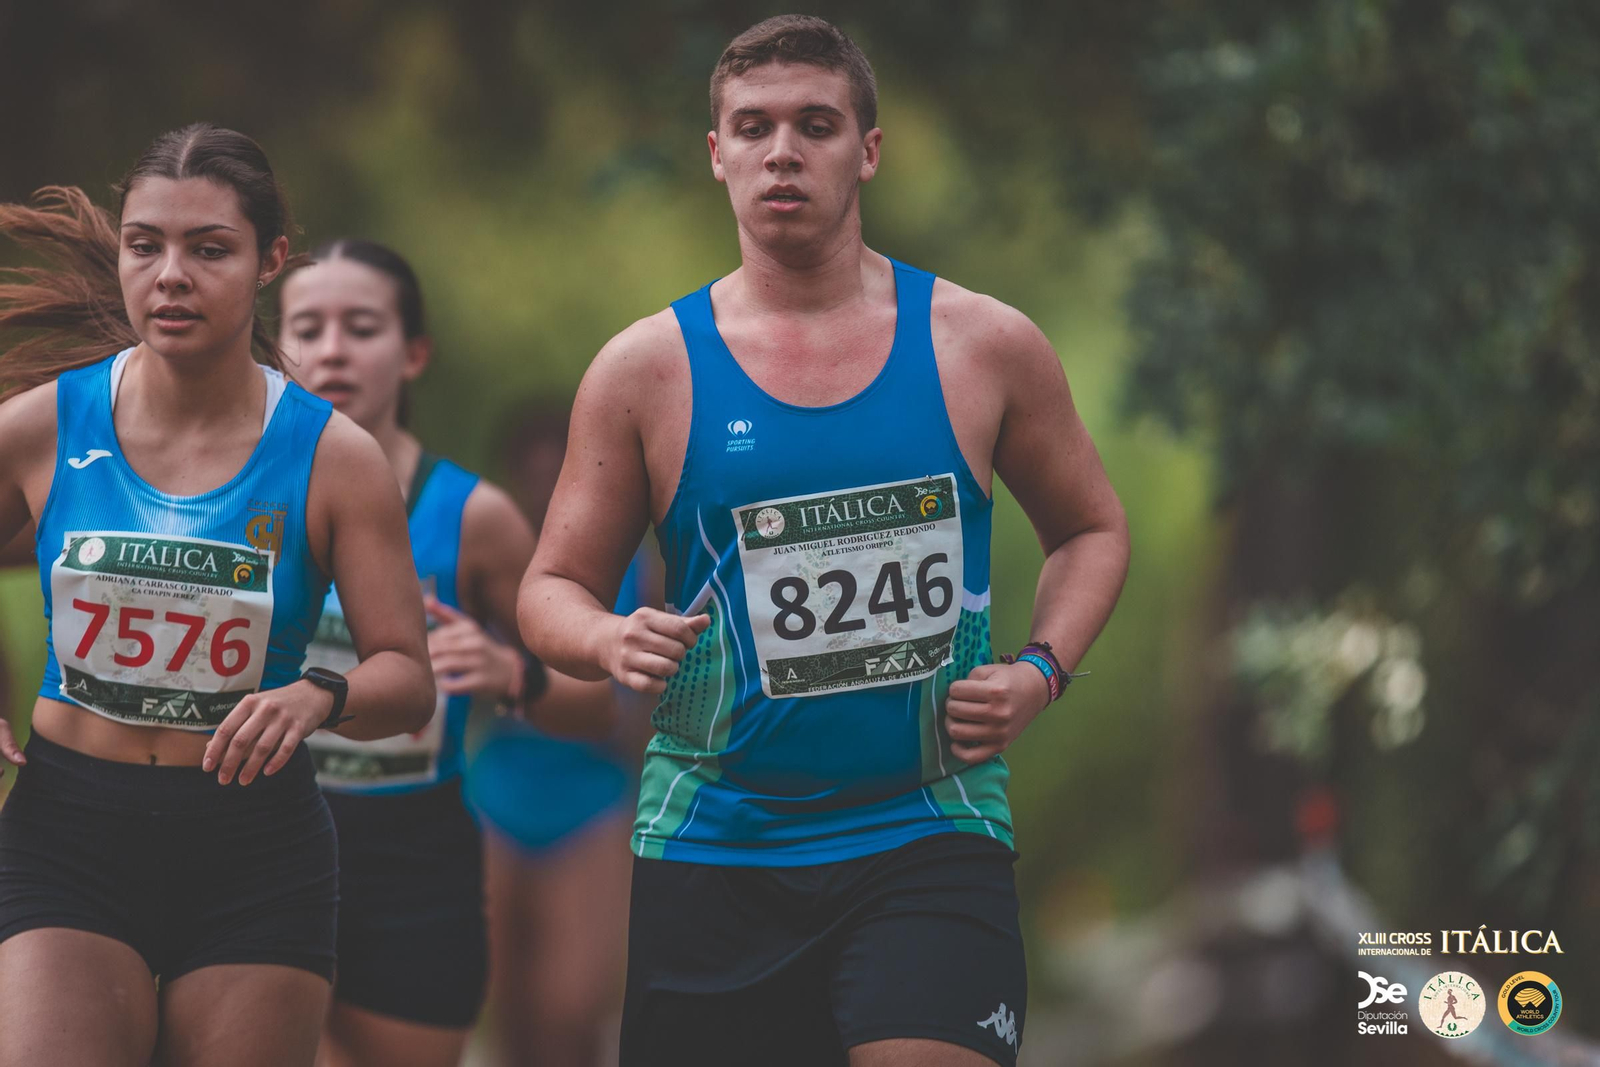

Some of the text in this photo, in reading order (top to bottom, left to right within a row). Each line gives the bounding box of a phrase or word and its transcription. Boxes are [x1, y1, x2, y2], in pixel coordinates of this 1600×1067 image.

[798, 493, 905, 528] ITÁLICA
[802, 521, 853, 534] INTERNATIONAL
[876, 513, 906, 522] COUNTRY
[773, 523, 936, 555] JUAN MIGUEL RODRIGUEZ REDONDO
[821, 540, 894, 557] ATLETISMO ORIPPO
[117, 541, 219, 573] ITÁLICA
[117, 562, 166, 573] INTERNATIONAL
[95, 574, 233, 597] ADRIANA CARRASCO PARRADO
[131, 587, 195, 600] CA CHAPIN JEREZ
[770, 552, 954, 641] 8246
[72, 598, 251, 677] 7576
[899, 668, 930, 679] ATLETISMO
